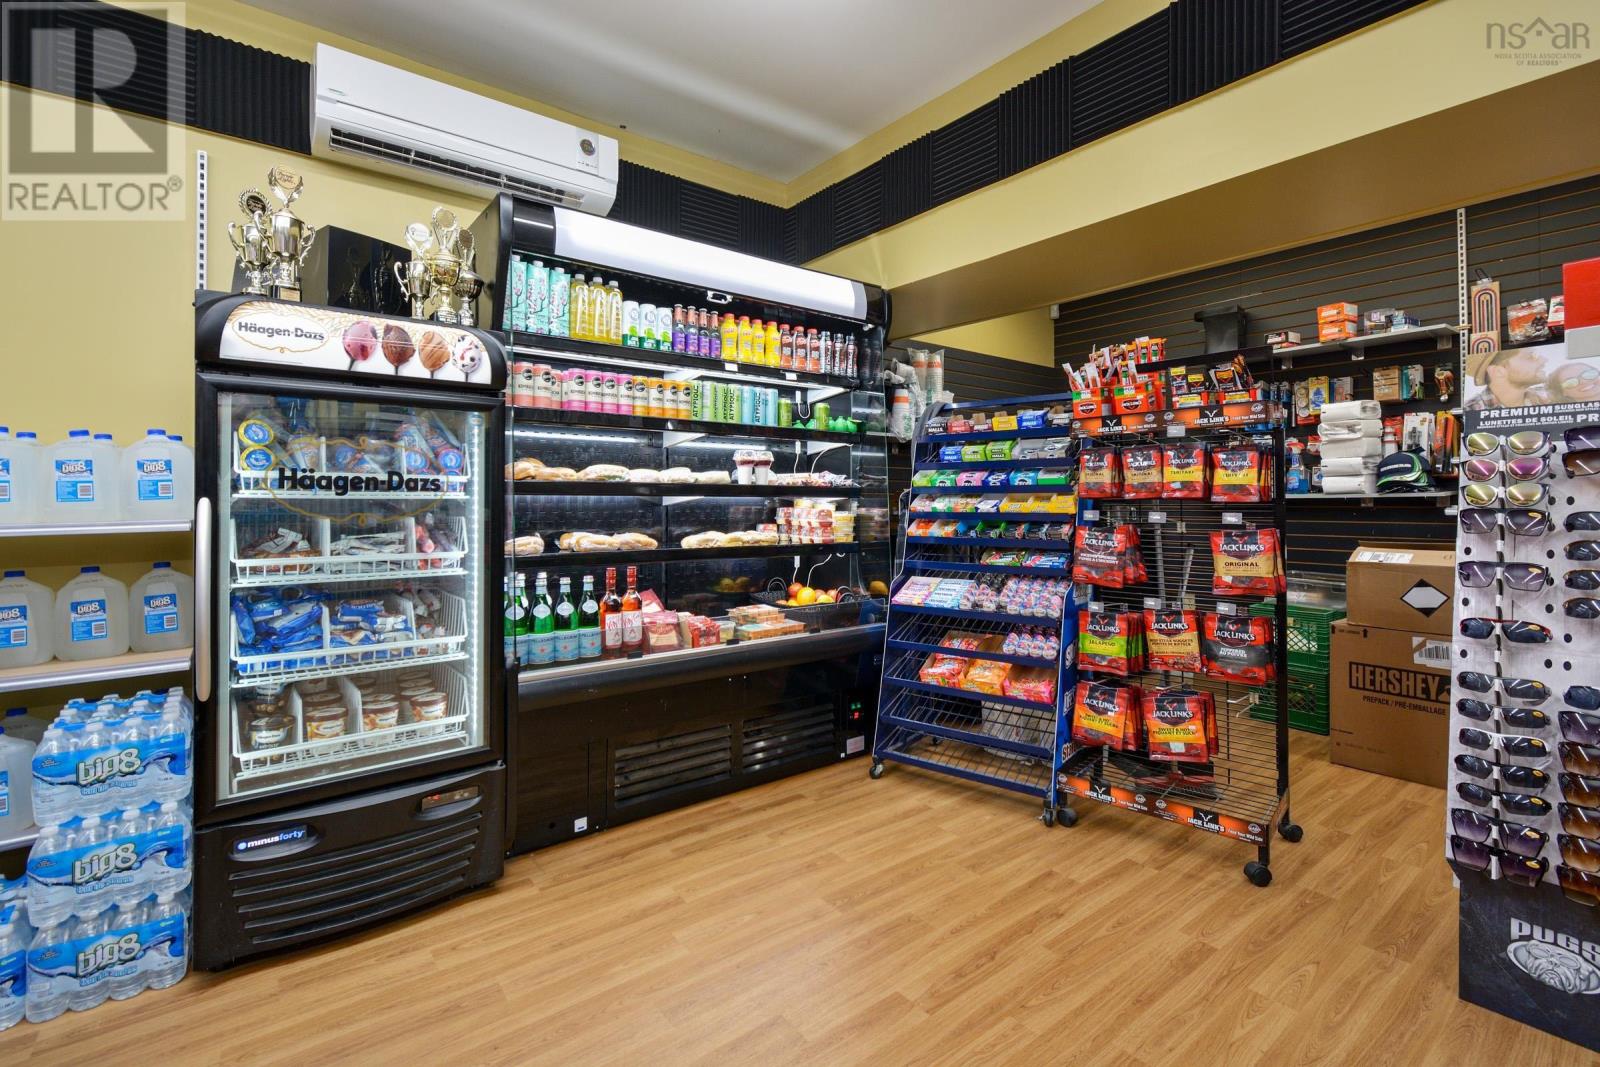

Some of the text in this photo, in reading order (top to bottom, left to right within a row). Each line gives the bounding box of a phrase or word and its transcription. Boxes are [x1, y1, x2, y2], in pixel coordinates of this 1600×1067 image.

[238, 321, 325, 341] Häagen-Dazs
[1480, 405, 1553, 419] PREMIUM
[1480, 418, 1523, 426] LUNETTES
[278, 467, 441, 496] Häagen-Dazs
[1214, 630, 1231, 638] JACK
[1351, 664, 1440, 700] HERSHEY
[1363, 695, 1390, 706] PREPACK
[77, 748, 141, 786] big8
[248, 830, 305, 848] minusforty
[73, 843, 138, 885] big8
[77, 933, 141, 977] big8
